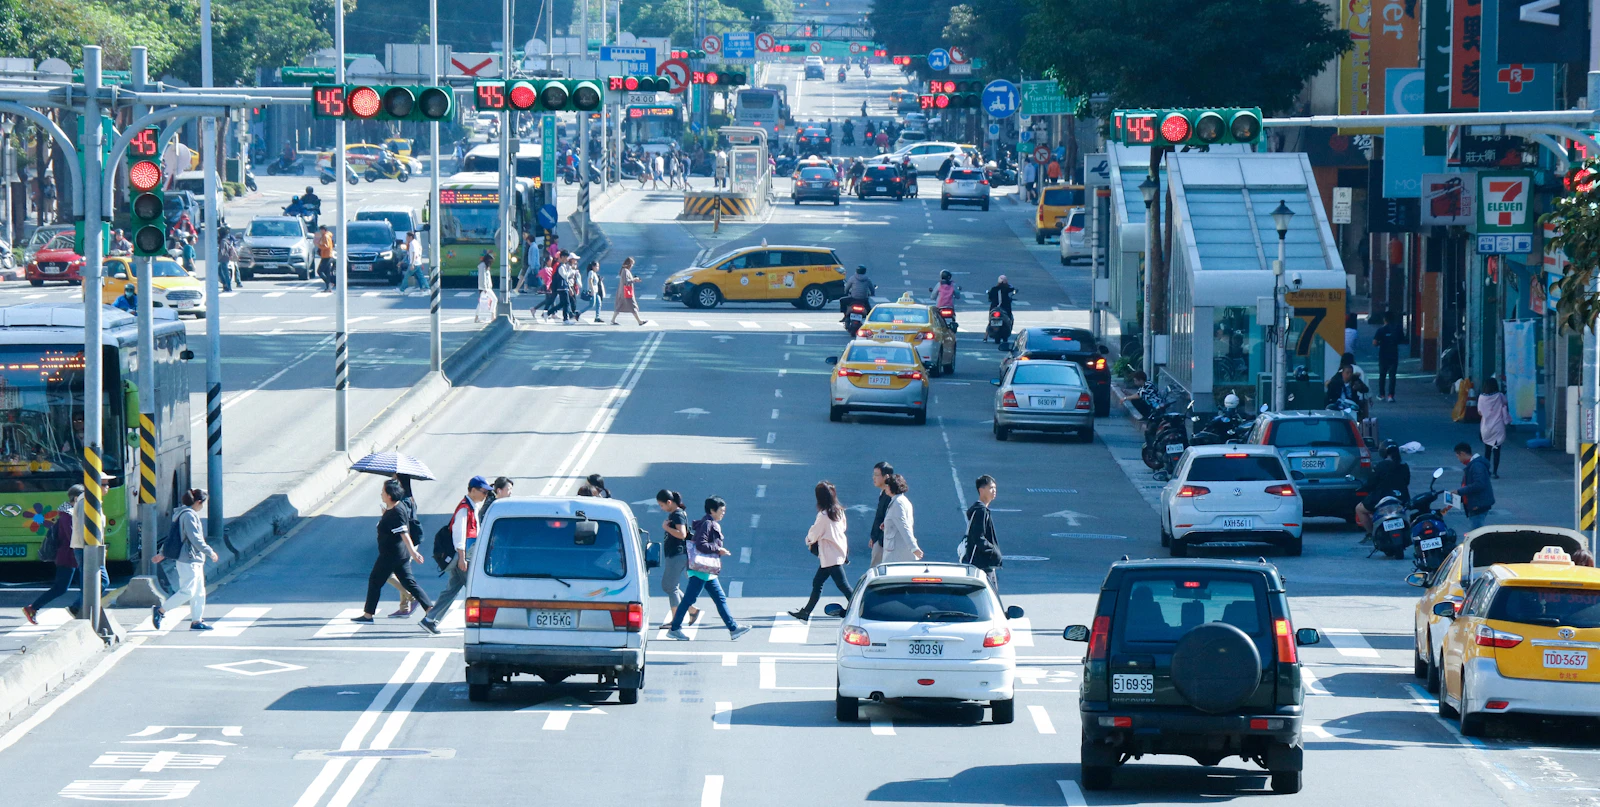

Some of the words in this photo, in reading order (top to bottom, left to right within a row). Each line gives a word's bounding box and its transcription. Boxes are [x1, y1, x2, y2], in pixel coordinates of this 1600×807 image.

[1382, 0, 1404, 40] er
[610, 77, 623, 91] 34
[693, 71, 705, 84] 34
[930, 80, 942, 93] 34
[316, 89, 344, 115] 45
[479, 85, 504, 107] 45
[921, 96, 934, 109] 34
[1127, 116, 1155, 143] 45
[130, 130, 157, 155] 45
[1395, 179, 1422, 190] MO-
[1489, 181, 1523, 226] 7
[1294, 307, 1327, 356] 7
[1544, 653, 1587, 666] TDD-3637
